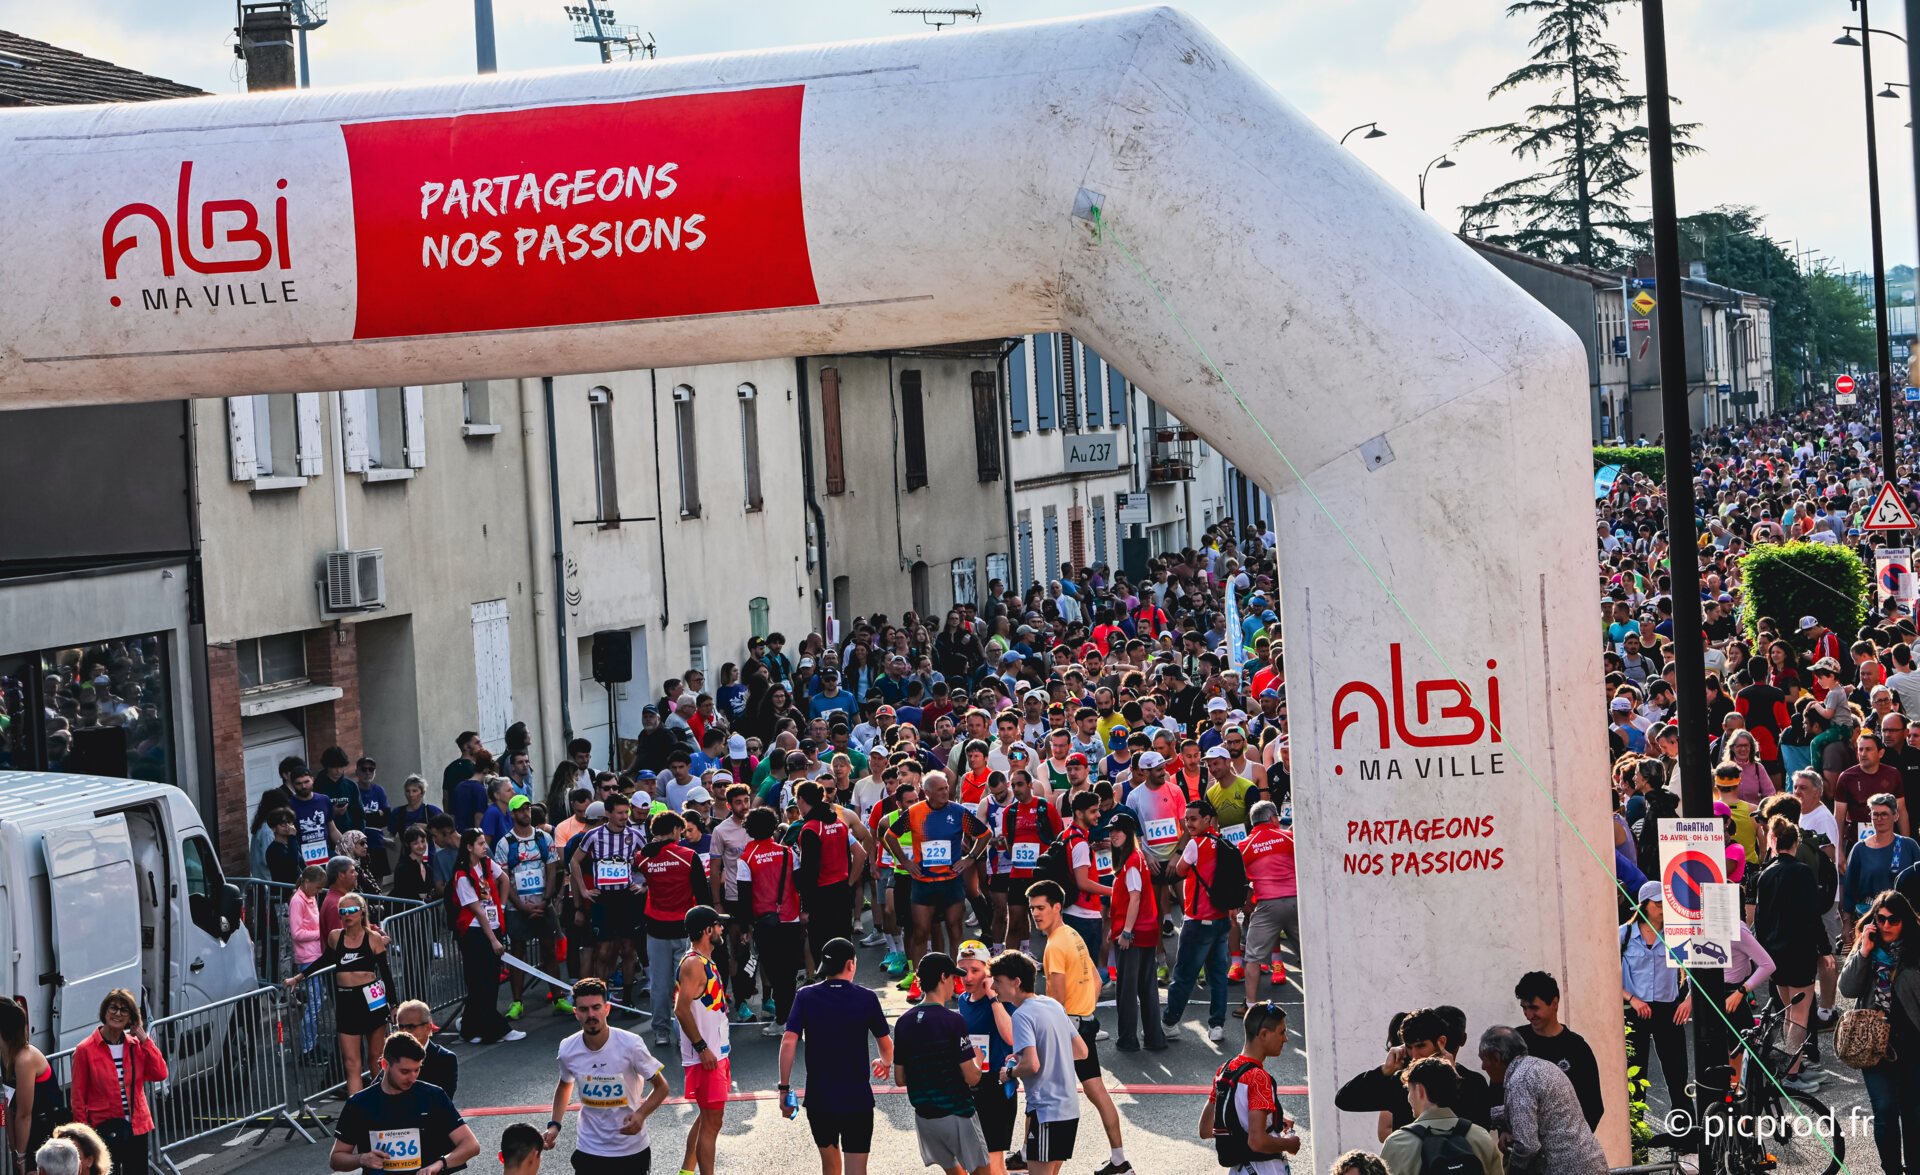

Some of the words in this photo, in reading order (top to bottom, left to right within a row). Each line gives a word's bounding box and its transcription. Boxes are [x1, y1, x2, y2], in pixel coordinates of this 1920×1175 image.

[420, 162, 679, 220] PARTAGEONS
[422, 230, 503, 269] NOS
[514, 214, 707, 266] PASSIONS
[142, 287, 193, 310] MA
[203, 280, 298, 306] VILLE
[1070, 445, 1087, 463] Au
[1088, 443, 1111, 461] 237
[1360, 759, 1402, 781] MA
[1415, 753, 1504, 778] VILLE
[1148, 825, 1176, 838] 1616
[1347, 815, 1494, 845] PARTAGEONS
[1252, 837, 1284, 849] Marathon
[304, 847, 326, 859] 1897
[926, 848, 947, 858] 229
[1016, 850, 1035, 860] 532
[647, 860, 679, 868] Marathon
[1344, 853, 1384, 875] NOS
[1391, 848, 1504, 877] PASSIONS
[600, 867, 627, 877] 1563
[521, 876, 541, 888] 308
[343, 952, 360, 960] NIKE
[582, 1083, 624, 1097] 4493
